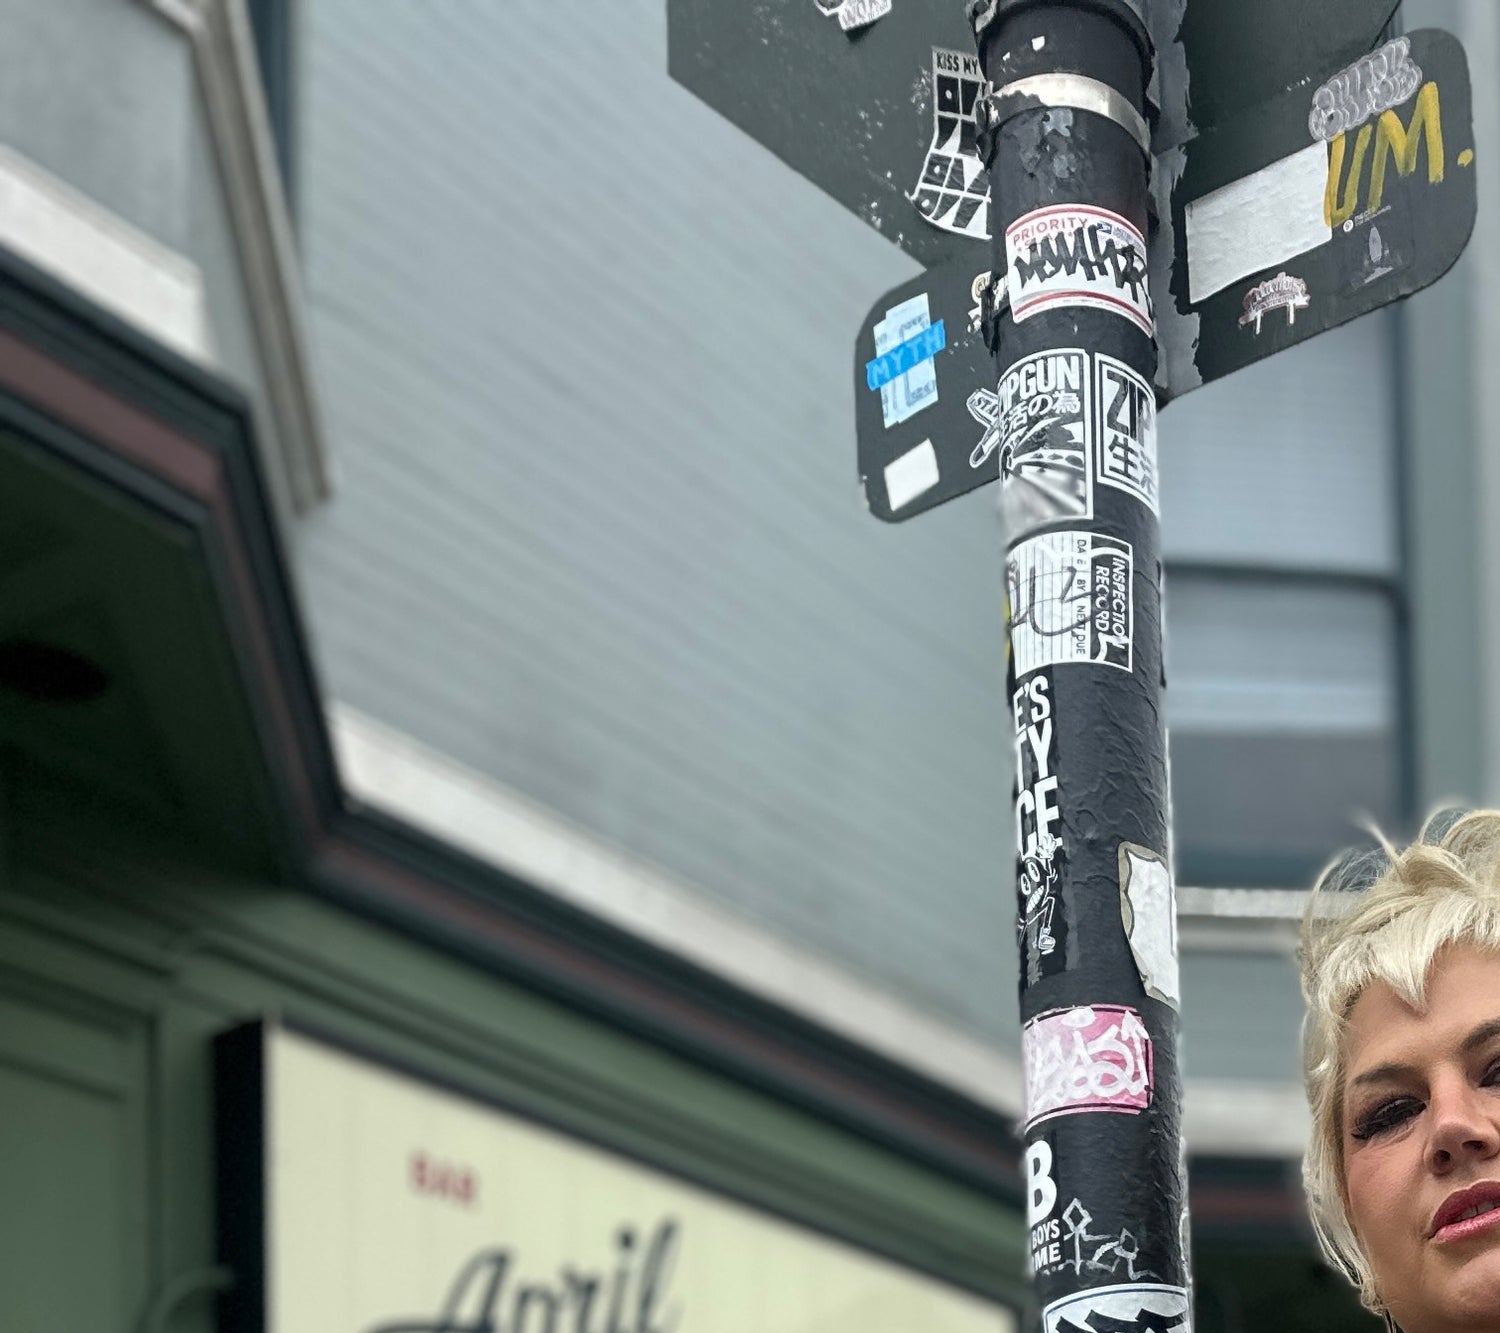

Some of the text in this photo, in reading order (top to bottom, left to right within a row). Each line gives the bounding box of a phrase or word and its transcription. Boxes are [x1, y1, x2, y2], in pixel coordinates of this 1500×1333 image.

[936, 53, 978, 76] KISS MY
[1013, 217, 1089, 247] PRIORITY
[872, 326, 944, 384] MYTH
[1076, 579, 1087, 592] BY
[1095, 565, 1110, 632] RECORD
[1075, 634, 1087, 655] DUE
[411, 1152, 477, 1206] BAR
[1033, 1241, 1062, 1272] ME
